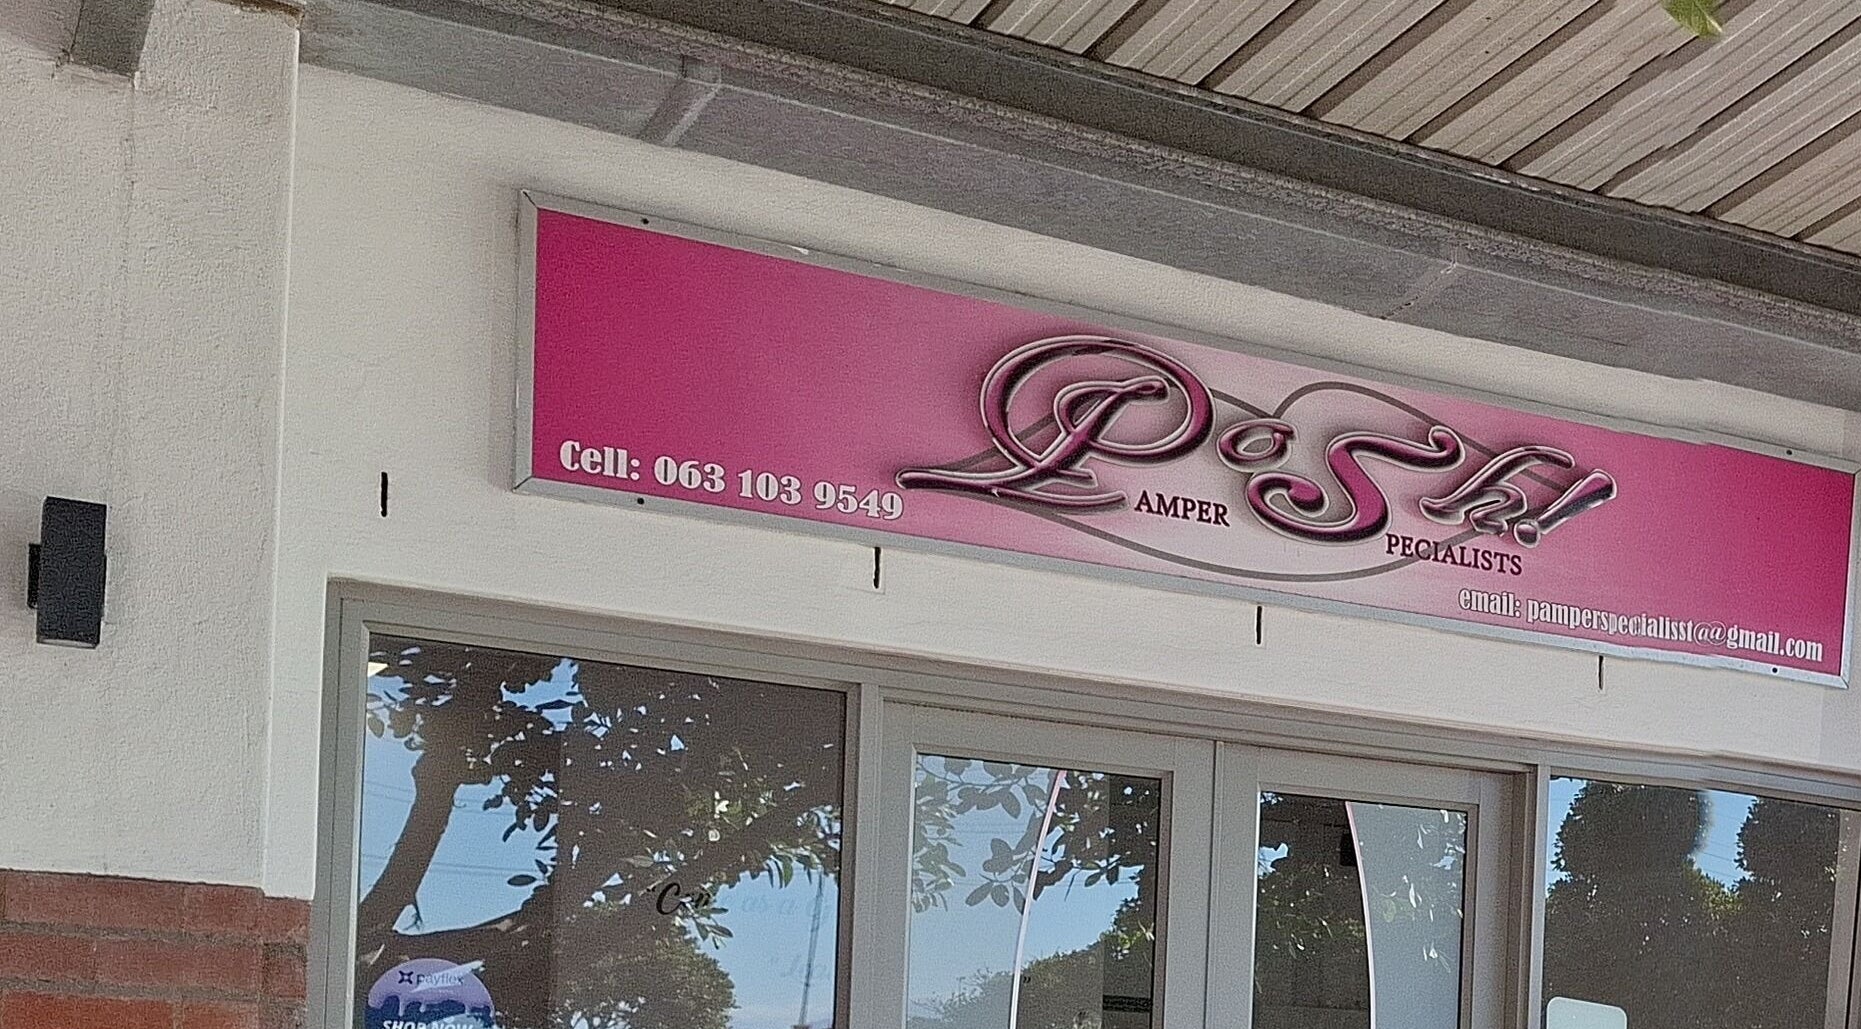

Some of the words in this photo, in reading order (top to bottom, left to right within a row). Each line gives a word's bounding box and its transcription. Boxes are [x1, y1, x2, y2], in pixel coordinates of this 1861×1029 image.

[559, 440, 641, 482] Cell:
[653, 454, 727, 493] 063
[737, 469, 802, 506] 103
[814, 483, 904, 520] 9549
[1134, 491, 1231, 529] AMPER
[1385, 532, 1523, 577] PECIALISTS
[1458, 587, 1522, 618] email:
